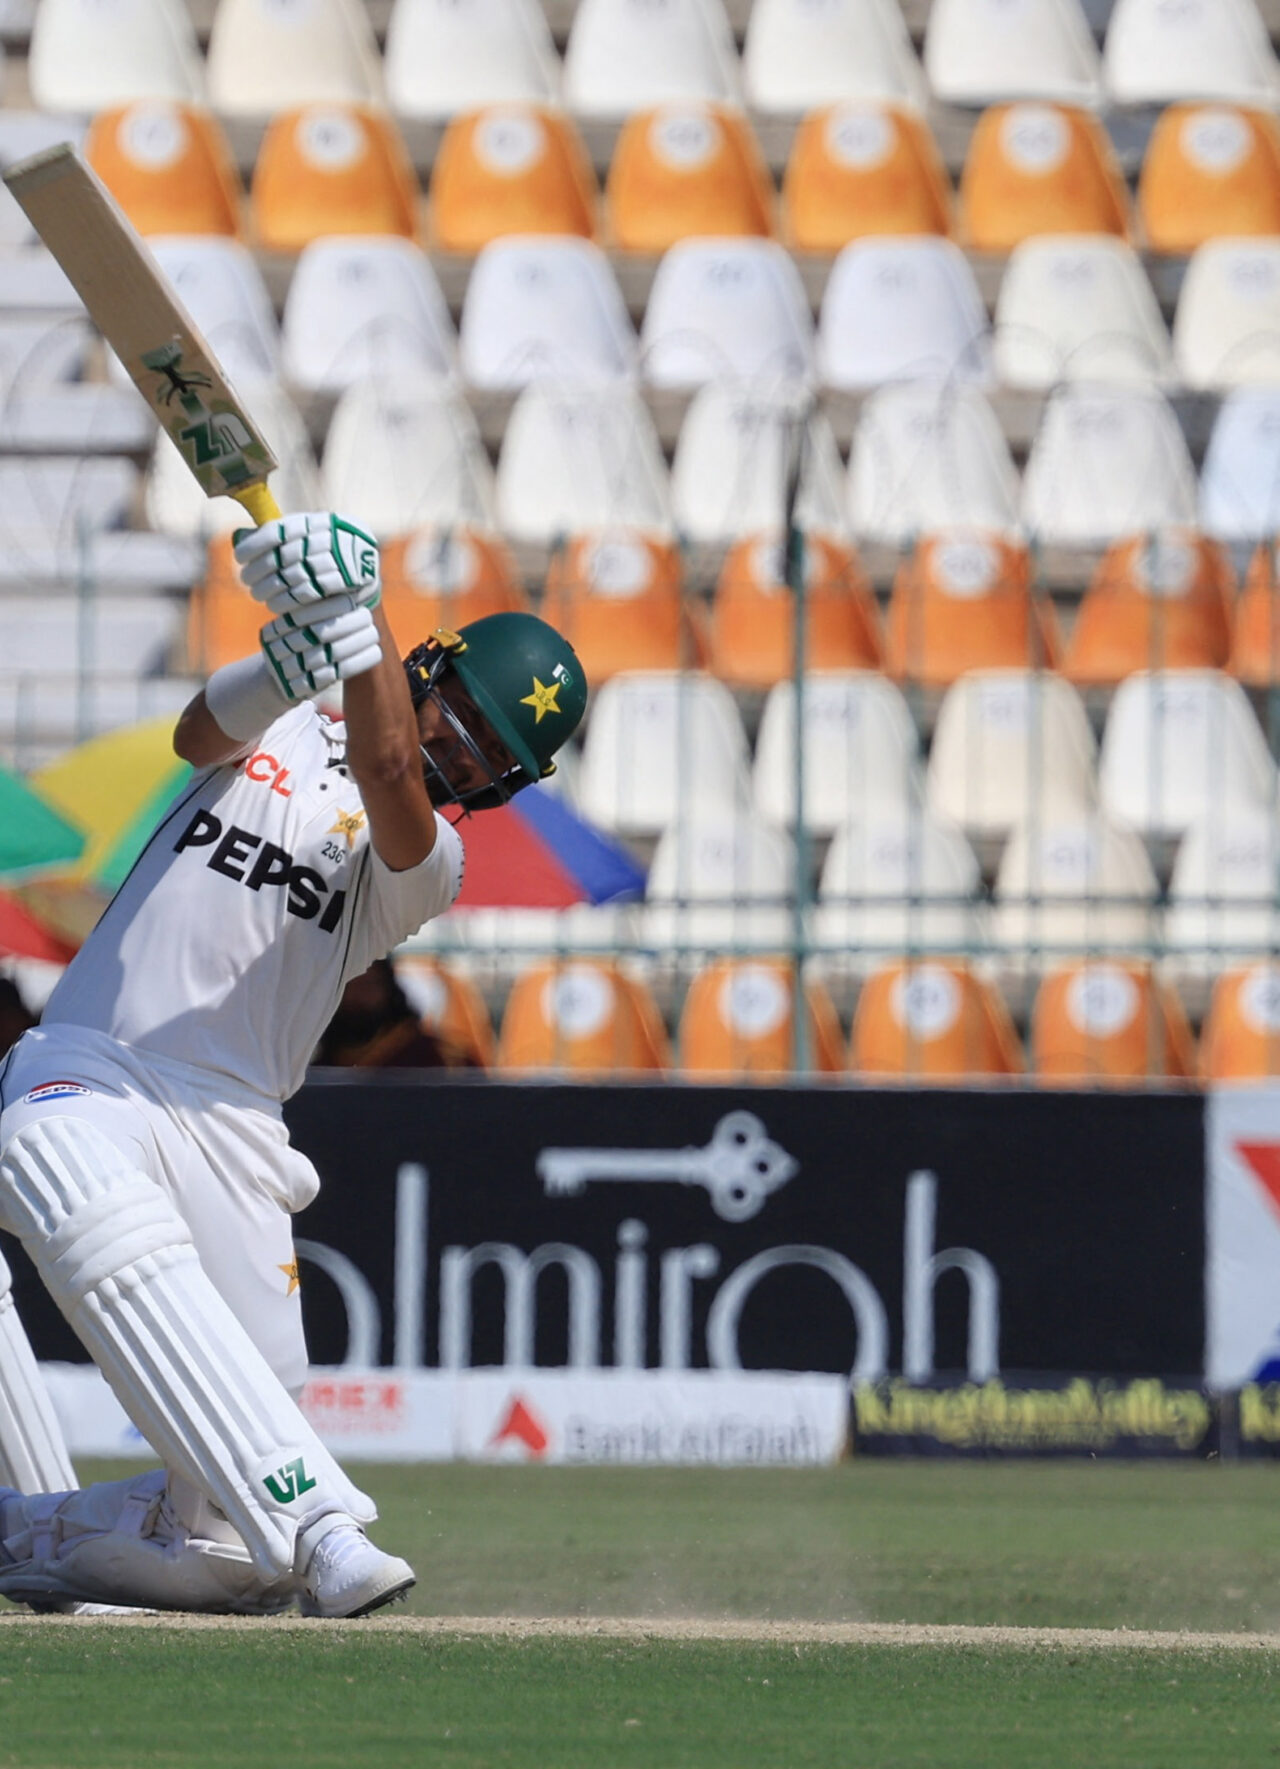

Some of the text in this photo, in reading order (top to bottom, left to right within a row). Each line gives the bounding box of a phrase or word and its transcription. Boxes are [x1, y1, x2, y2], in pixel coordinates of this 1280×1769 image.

[173, 808, 346, 933] PEPSI
[321, 840, 346, 864] 236
[263, 1456, 317, 1504] UZ
